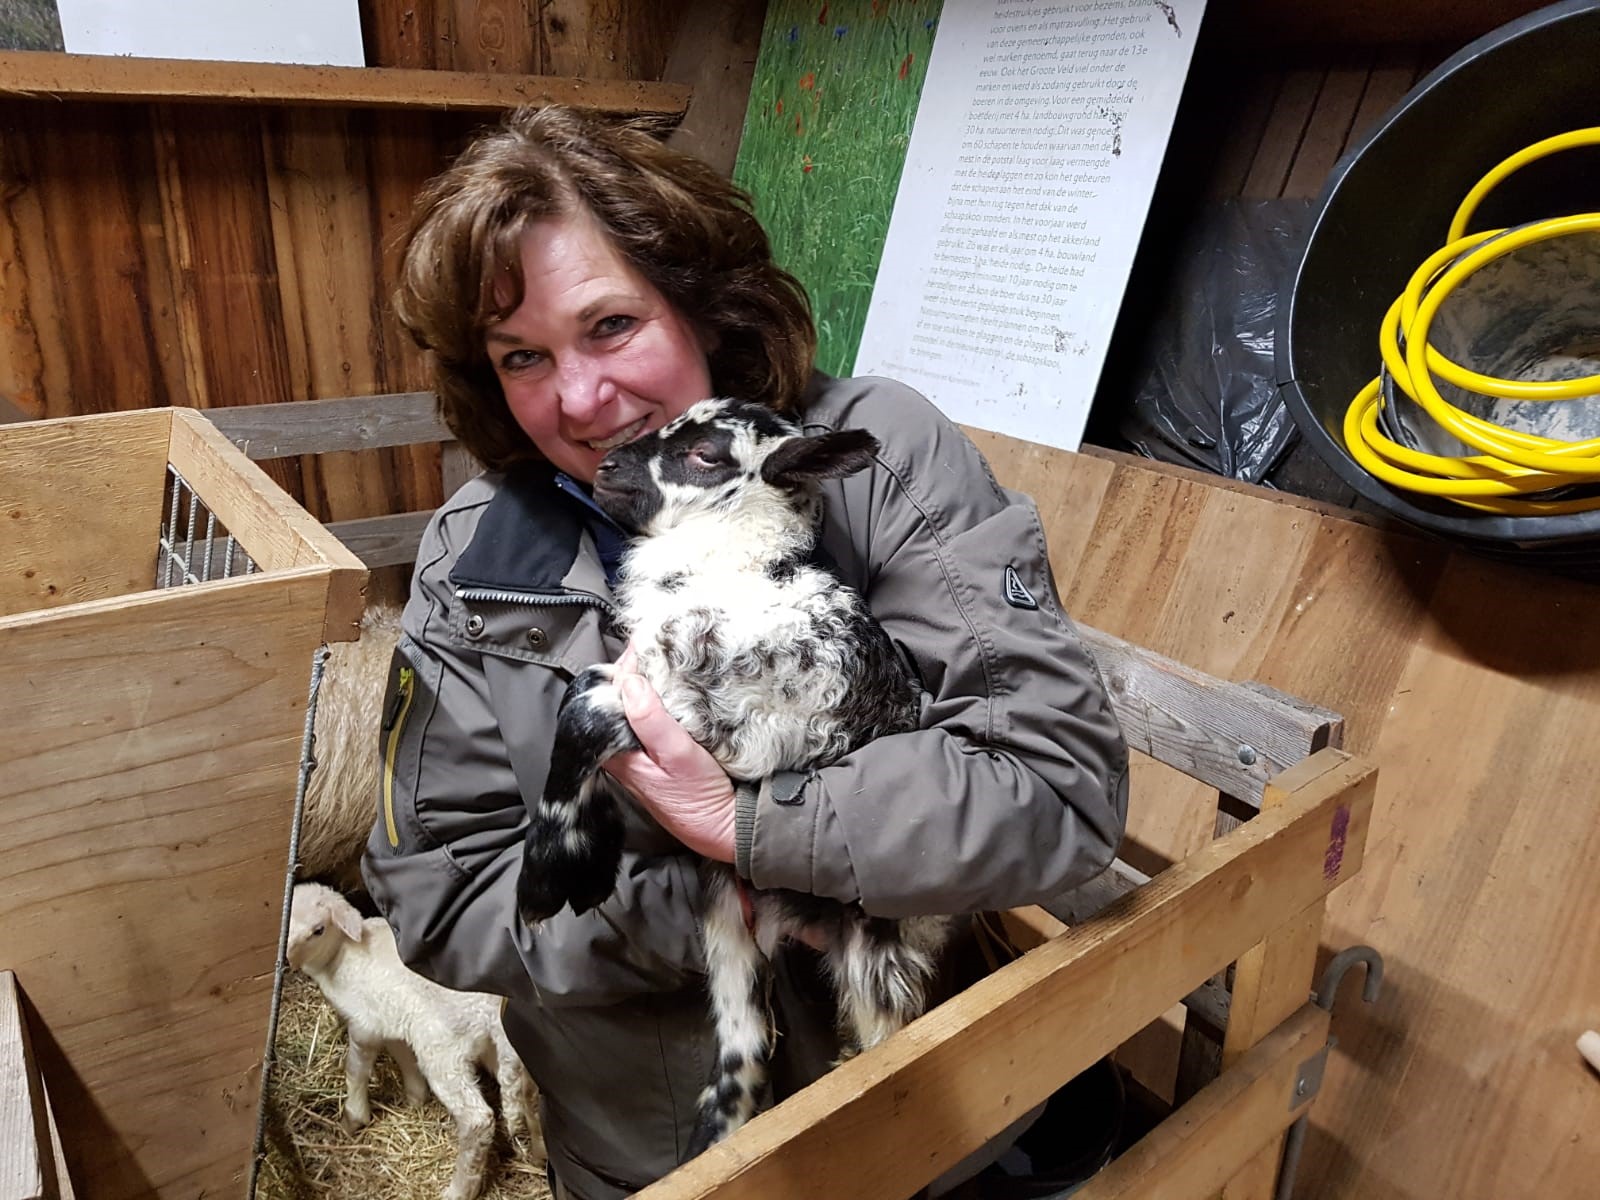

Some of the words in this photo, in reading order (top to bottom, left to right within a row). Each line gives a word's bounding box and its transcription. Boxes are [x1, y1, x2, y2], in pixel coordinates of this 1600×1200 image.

[1041, 5, 1074, 18] gebruikt
[990, 25, 1006, 34] voor
[1007, 24, 1027, 33] ovens
[1103, 15, 1118, 25] Het
[1119, 13, 1152, 27] gebruik
[986, 40, 999, 48] van
[999, 38, 1016, 47] deze
[1092, 30, 1127, 44] gronden,
[1129, 29, 1145, 40] ook
[983, 53, 996, 62] wel
[996, 51, 1022, 62] marken
[1022, 49, 1058, 64] genoemd,
[1060, 50, 1076, 61] gaat
[1078, 49, 1098, 60] terug
[1131, 44, 1148, 55] 13e
[1000, 66, 1015, 77] Ook
[1016, 66, 1029, 76] het
[1030, 65, 1056, 75] Groote
[1057, 64, 1074, 74] Veld
[1075, 63, 1089, 73] viel
[1089, 63, 1114, 73] onder
[1114, 62, 1126, 72] de
[976, 82, 1000, 91] marken
[1011, 81, 1031, 91] werd
[1041, 80, 1071, 92] zodanig
[1071, 79, 1105, 92] gebruikt
[1105, 78, 1126, 89] door
[1126, 77, 1138, 87] de
[972, 97, 995, 106] boeren
[1052, 96, 1071, 104] Voor
[1086, 95, 1133, 107] gemiddelde
[1000, 112, 1014, 120] met
[1033, 110, 1093, 122] landbouwgrond
[986, 126, 1031, 135] natuurterrein
[1057, 124, 1069, 134] Dit
[1071, 127, 1085, 135] was
[983, 141, 1011, 151] schapen
[1020, 141, 1047, 150] houden
[1049, 143, 1080, 151] waarvan
[1082, 143, 1100, 151] men
[959, 155, 974, 163] mest
[992, 155, 1015, 165] potstal
[1016, 155, 1031, 167] laag
[1049, 157, 1065, 168] laag
[1066, 157, 1110, 169] vermengde
[978, 168, 1022, 182] heideplaggen
[1045, 172, 1058, 180] kon
[1060, 172, 1072, 181] het
[1073, 171, 1111, 184] gebeuren
[971, 184, 999, 194] schapen
[1012, 186, 1024, 194] het
[1024, 186, 1041, 195] eind
